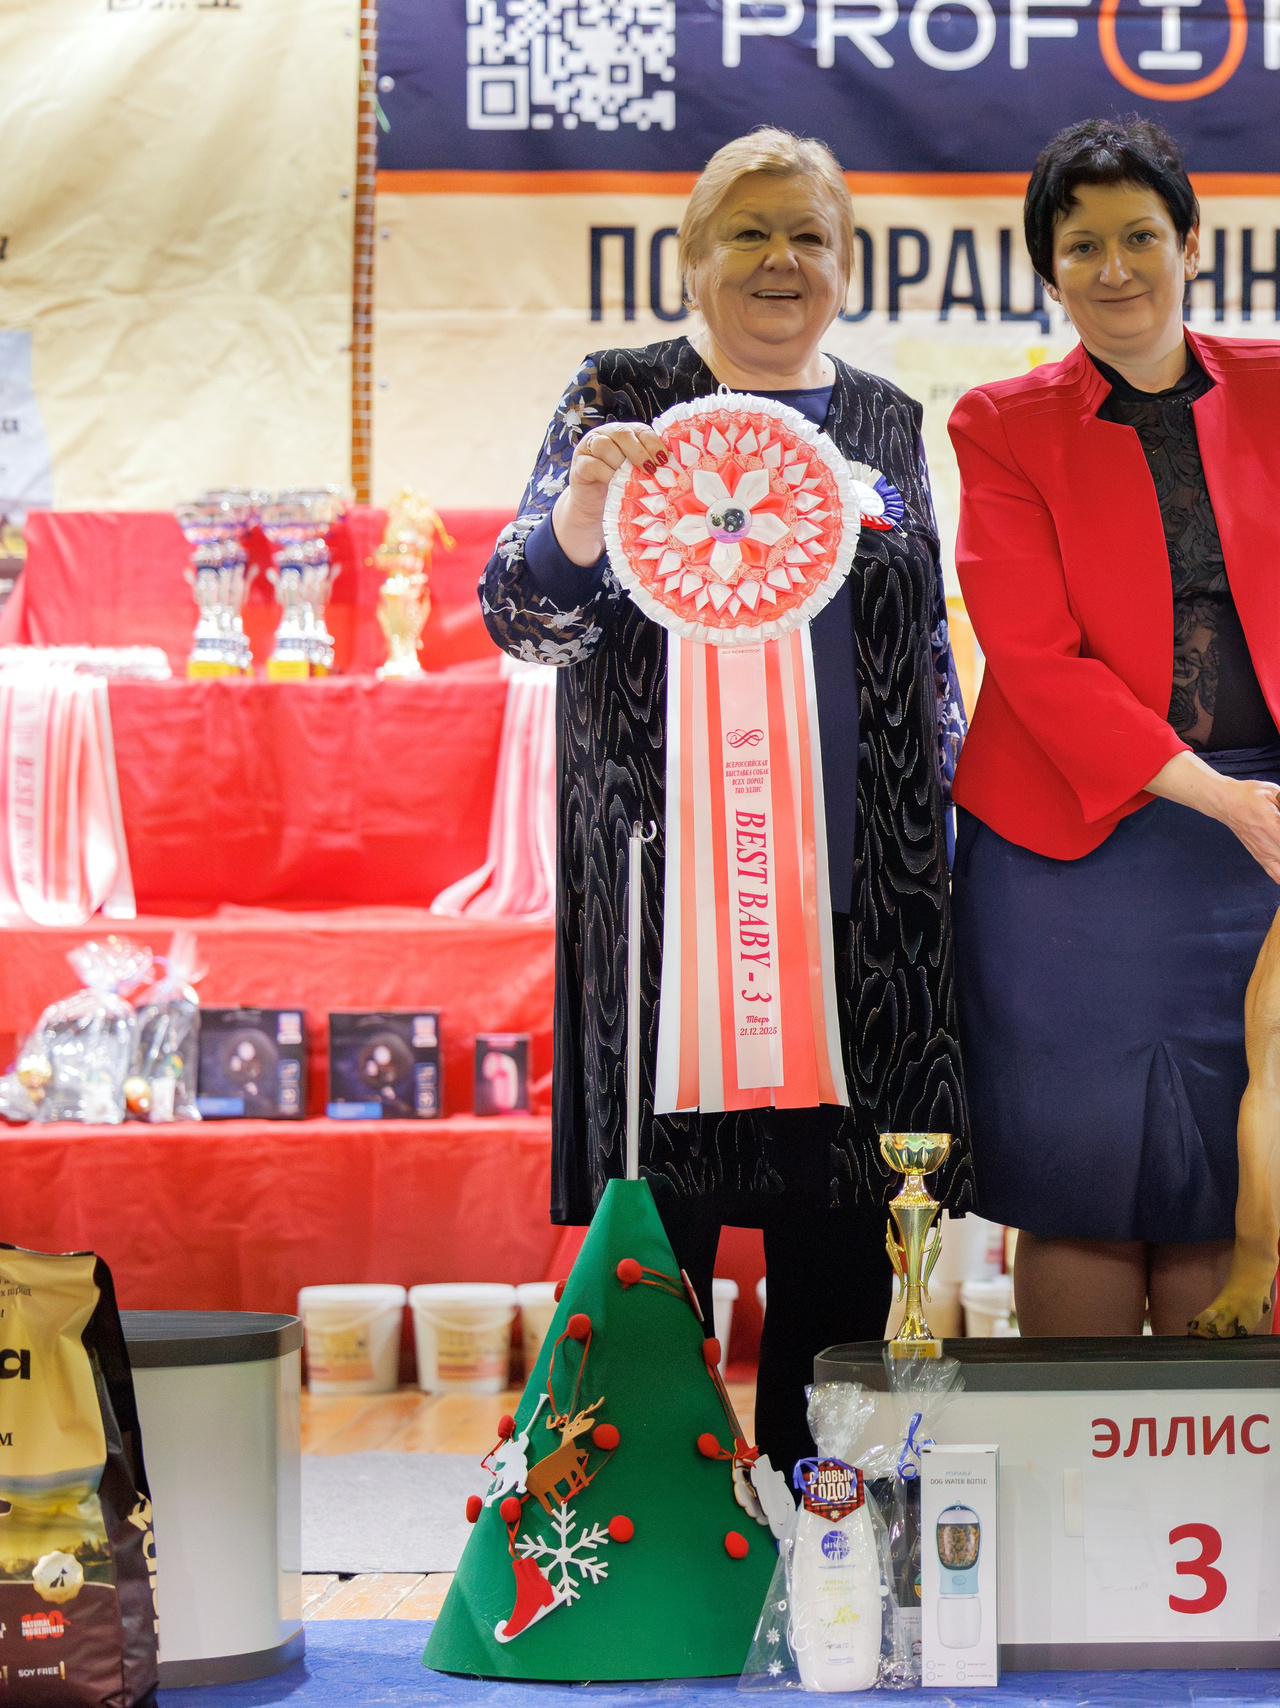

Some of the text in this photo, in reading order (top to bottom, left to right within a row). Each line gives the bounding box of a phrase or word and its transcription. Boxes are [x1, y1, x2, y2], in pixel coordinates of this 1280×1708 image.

[726, 759, 768, 768] ВСЕРОССИЙСКАЯ
[726, 768, 769, 777] ВЫСТАВКА СОБАК
[747, 777, 764, 785] ПОРОД
[735, 809, 768, 884] BEST
[738, 889, 771, 968] BABY
[741, 989, 772, 1003] 3
[745, 1015, 770, 1025] Тверь
[740, 1027, 778, 1036] 21.12.2025
[1091, 1414, 1271, 1458] ЭЛЛИС
[1168, 1522, 1228, 1615] 3
[21, 1619, 50, 1629] NATURAL
[22, 1625, 64, 1637] INGREDIENTS
[18, 1666, 59, 1677] SOY FREE
